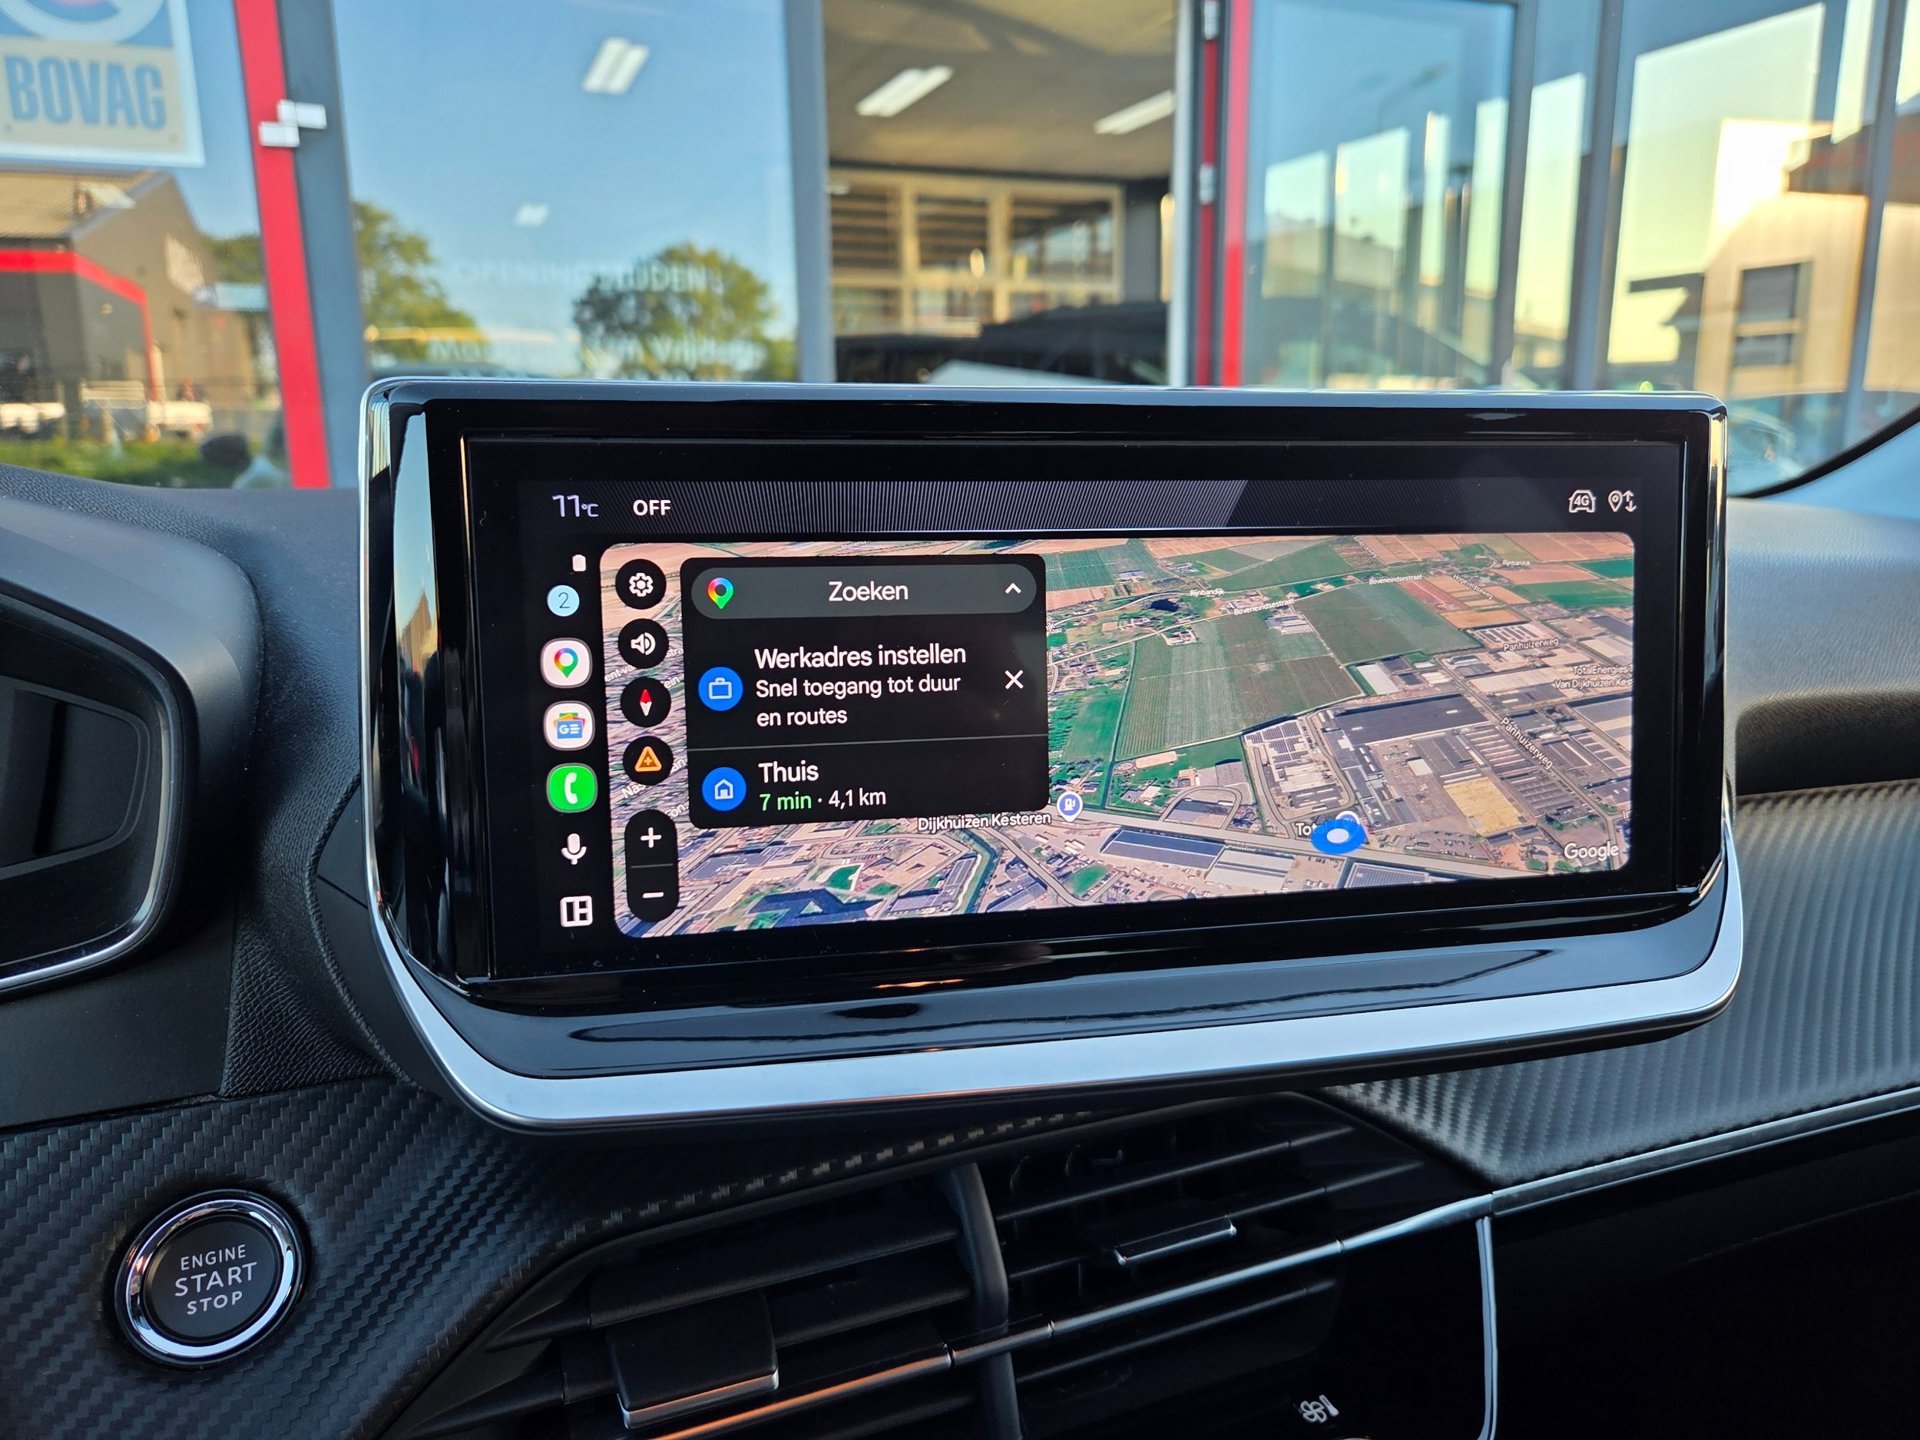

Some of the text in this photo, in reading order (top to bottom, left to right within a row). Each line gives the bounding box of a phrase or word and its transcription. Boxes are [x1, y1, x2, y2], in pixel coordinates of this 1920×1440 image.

[5, 56, 167, 131] BOVAG
[633, 499, 671, 516] OFF
[1573, 495, 1590, 506] 4G
[558, 592, 570, 609] 2
[828, 580, 909, 602] Zoeken
[754, 643, 967, 669] Werkadres instellen
[1503, 638, 1560, 652] Panhuizerweg
[755, 673, 962, 700] Snel toegang tot duur
[1554, 680, 1571, 689] Van
[1571, 679, 1614, 690] Dijkhuizen
[756, 708, 848, 727] en routes
[1500, 716, 1554, 770] Panhuizerweg
[758, 760, 820, 783] Thuis
[759, 787, 887, 811] 7 min 4,1 km
[918, 813, 1052, 834] Dijkhuizen Kesteren
[1563, 841, 1619, 861] Google
[180, 1244, 247, 1271] ENGINE
[174, 1261, 258, 1297] START
[186, 1290, 243, 1315] STOP
